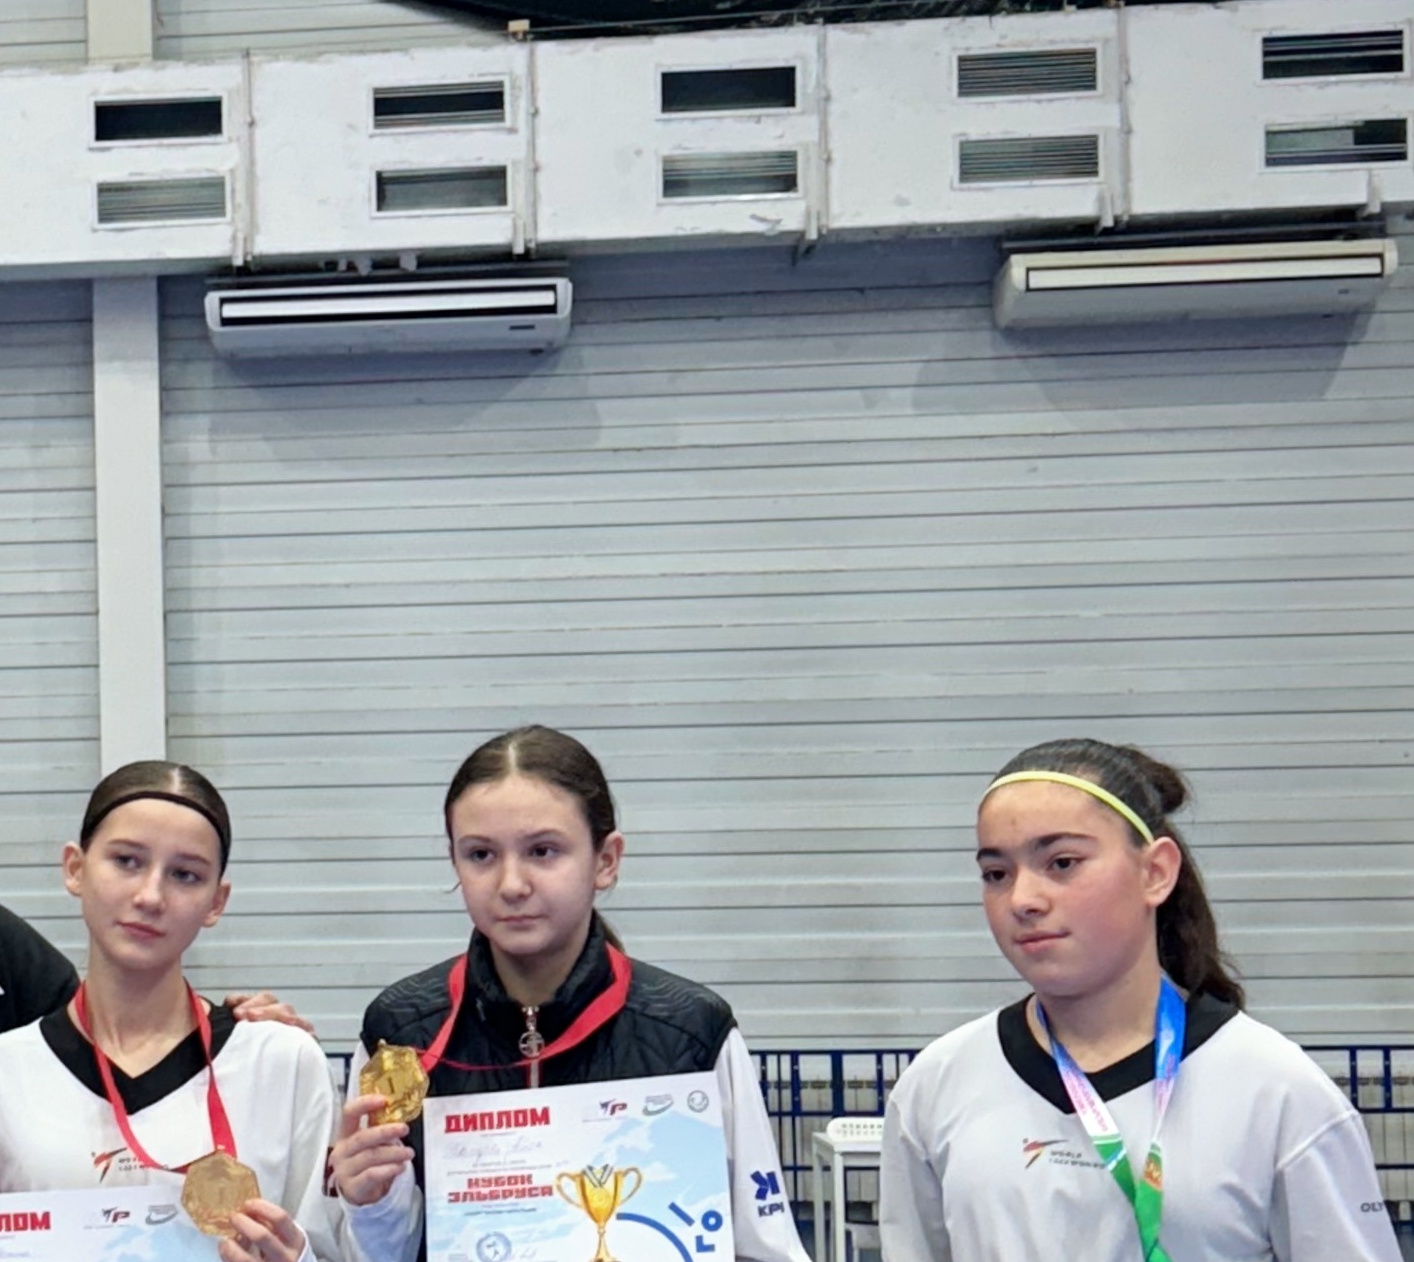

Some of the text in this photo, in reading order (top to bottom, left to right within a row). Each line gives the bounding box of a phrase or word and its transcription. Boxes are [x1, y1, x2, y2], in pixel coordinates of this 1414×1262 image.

[444, 1106, 550, 1134] ДИПЛОМ
[467, 1174, 533, 1190] КУБОК
[447, 1185, 554, 1204] ЭЛЬБРУСА
